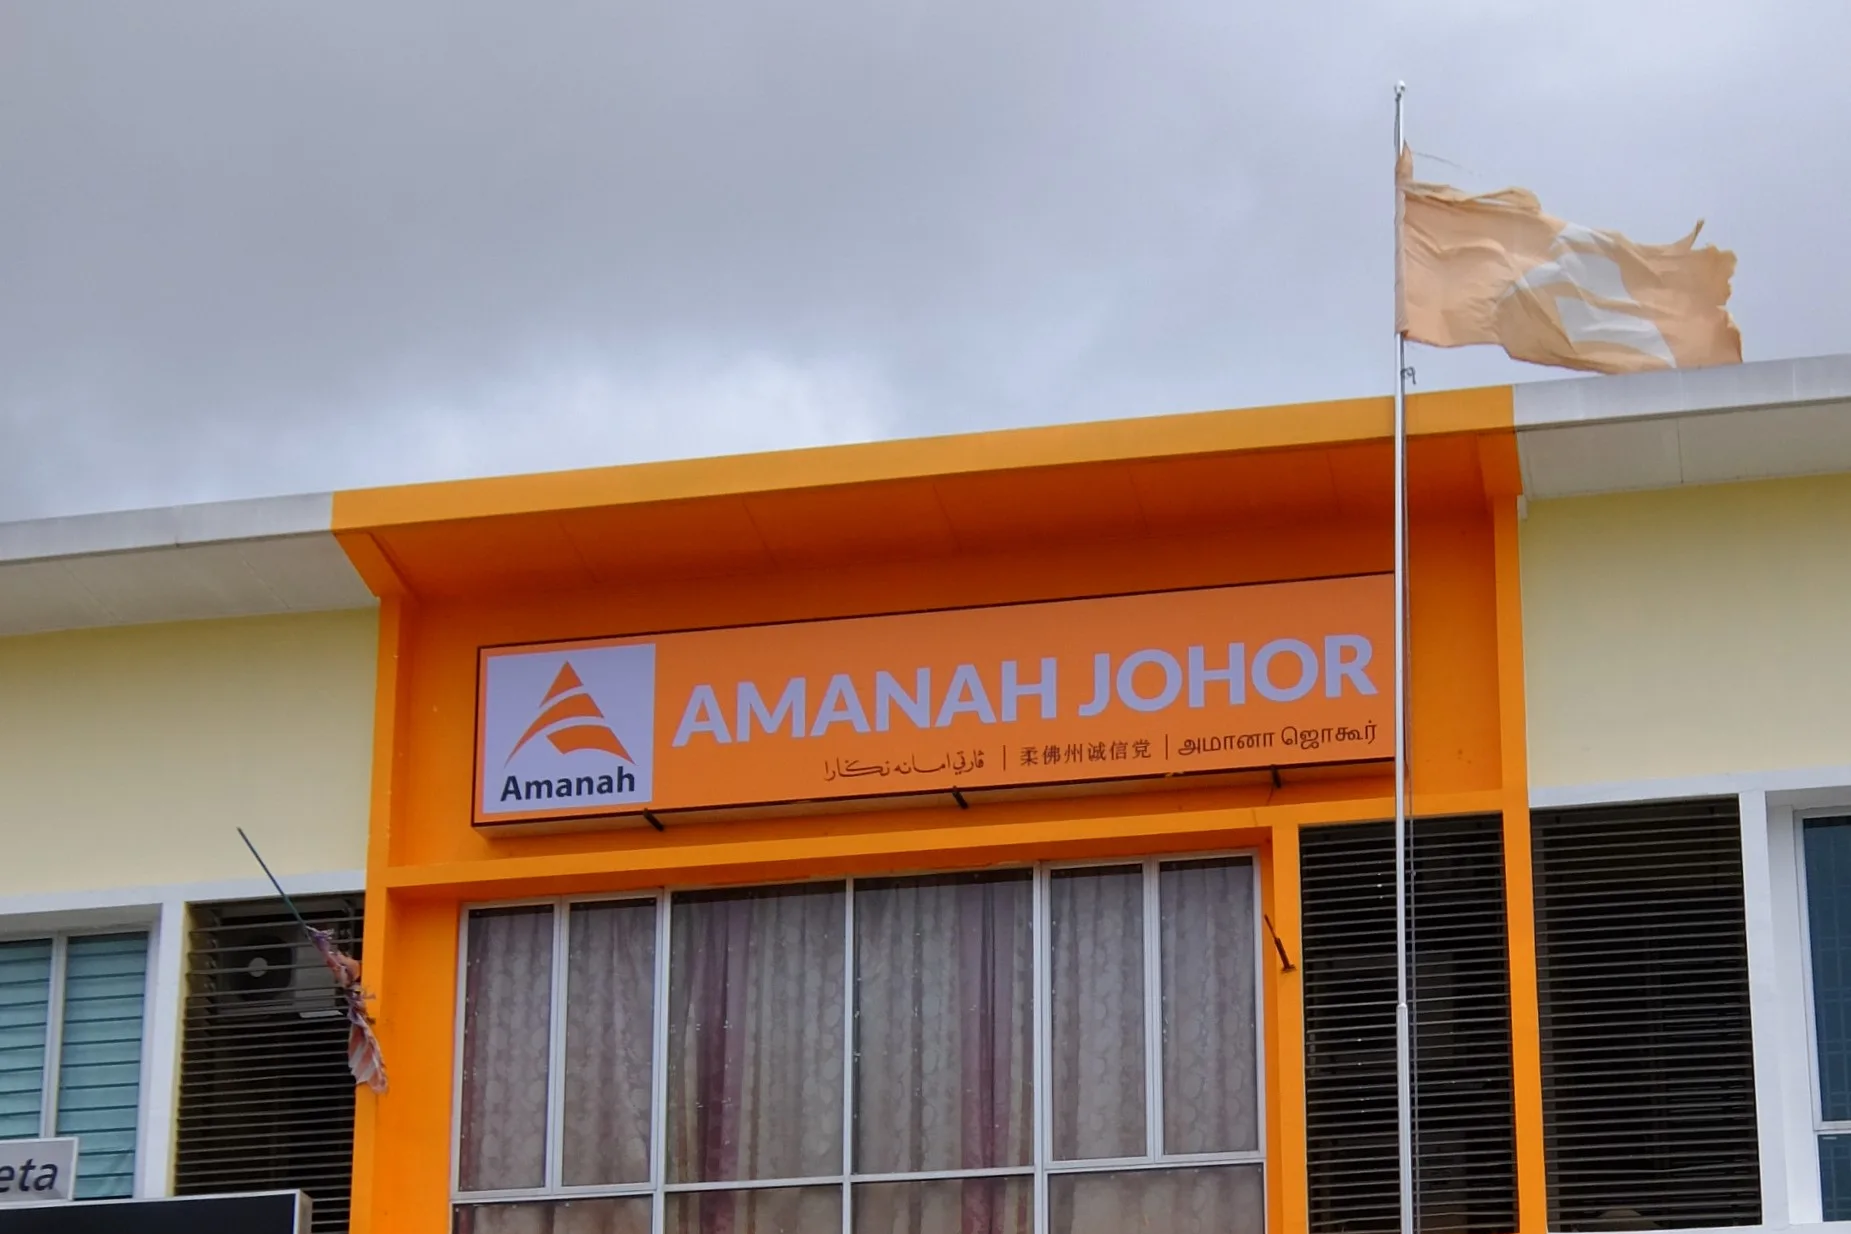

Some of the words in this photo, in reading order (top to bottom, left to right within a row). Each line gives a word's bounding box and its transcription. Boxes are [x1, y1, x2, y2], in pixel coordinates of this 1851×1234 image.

[672, 658, 1058, 748] AMANAH
[1077, 634, 1379, 717] JOHOR
[1019, 738, 1152, 766] 柔佛州诚信党
[1178, 731, 1276, 756] அமானா
[500, 766, 636, 802] Amanah
